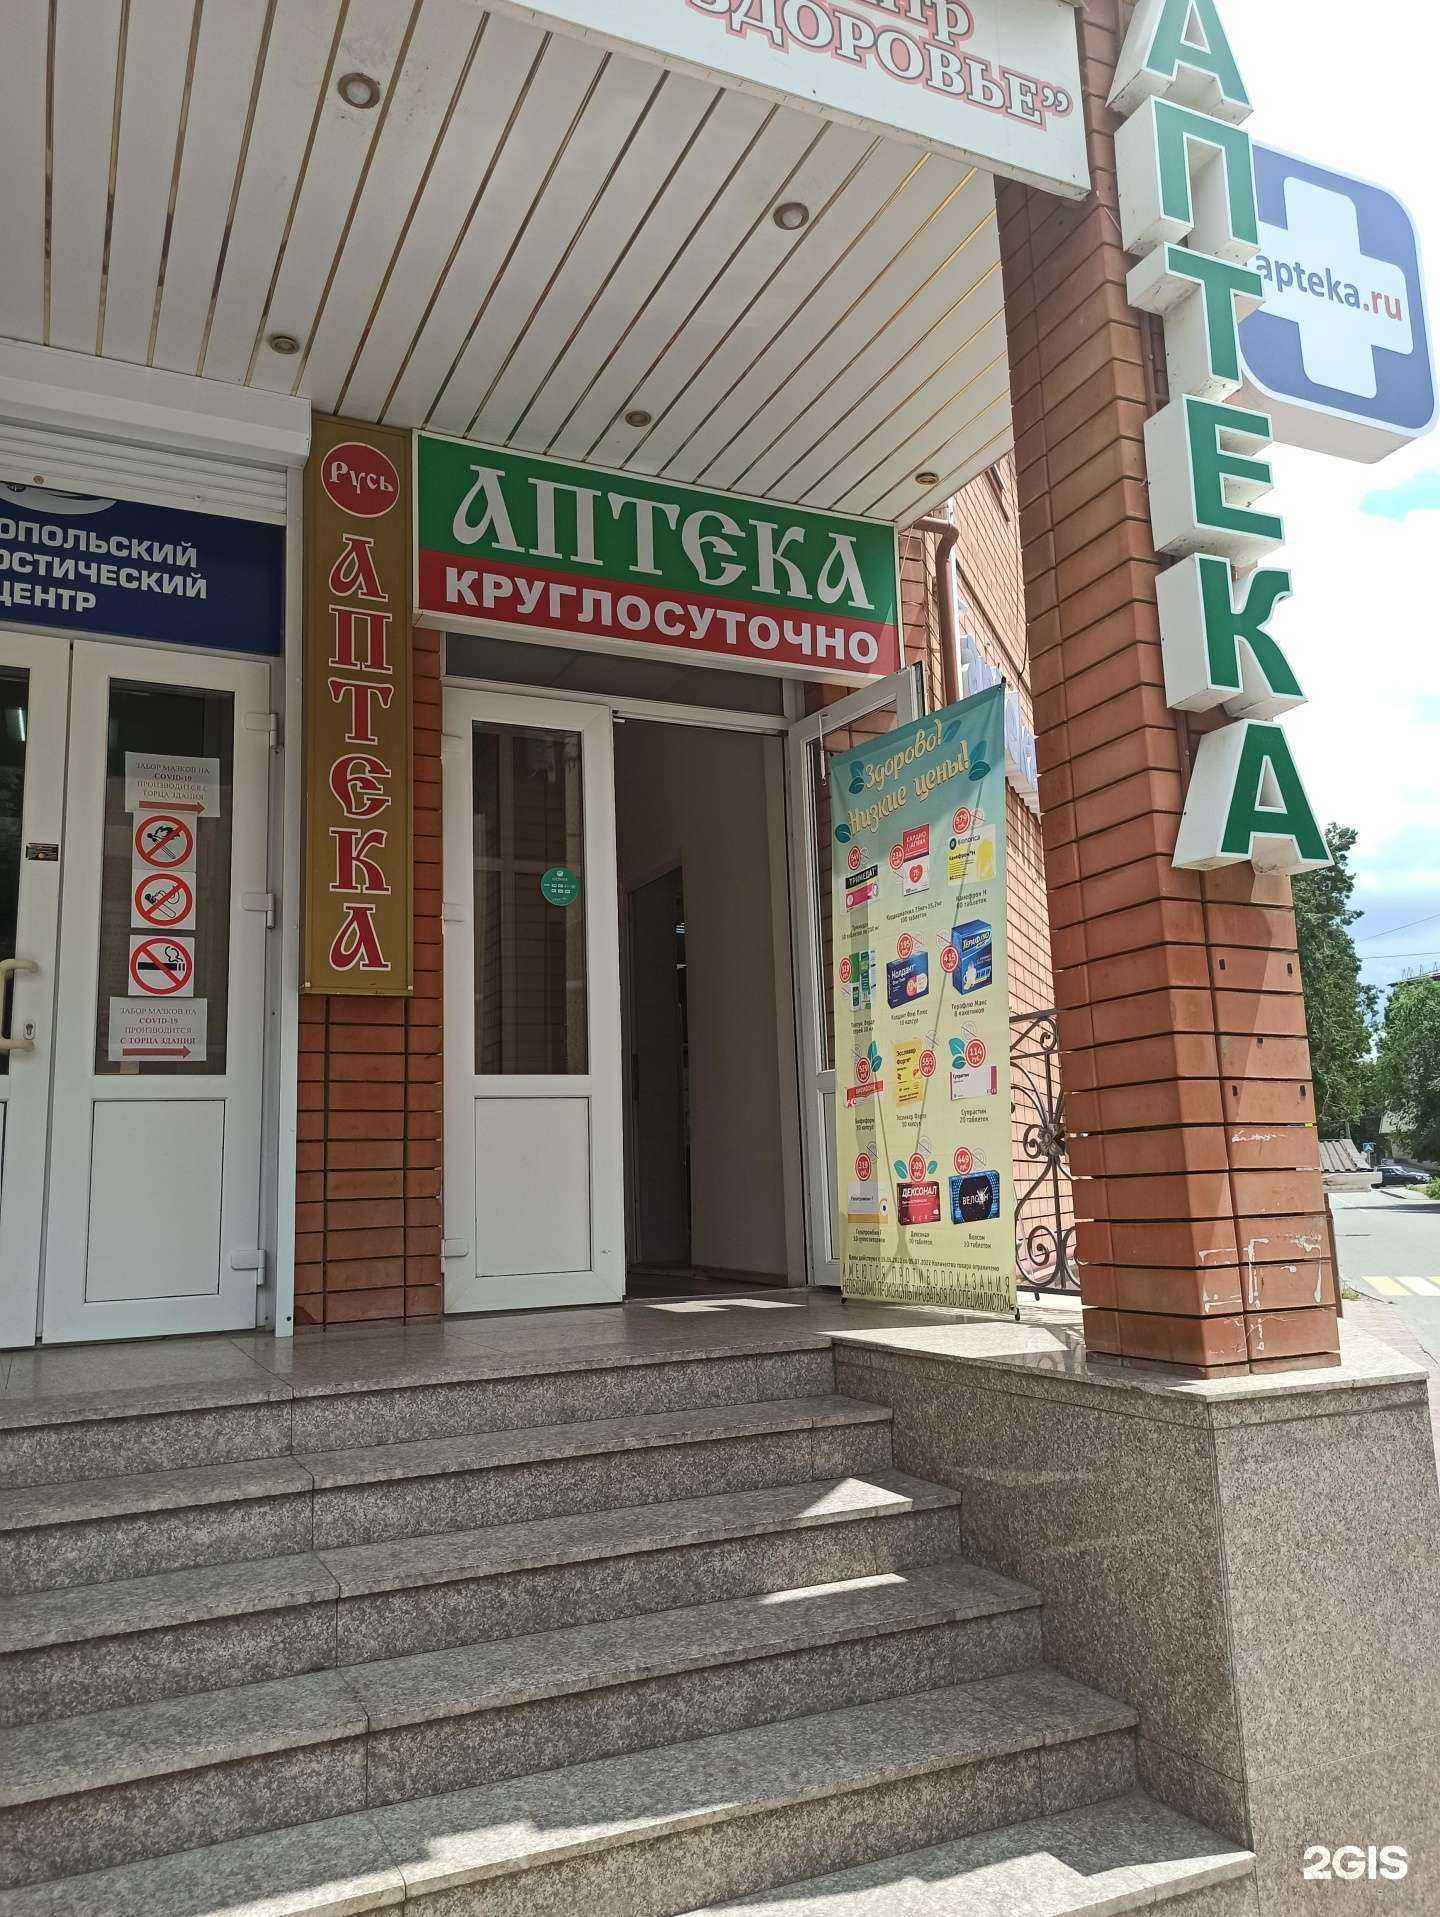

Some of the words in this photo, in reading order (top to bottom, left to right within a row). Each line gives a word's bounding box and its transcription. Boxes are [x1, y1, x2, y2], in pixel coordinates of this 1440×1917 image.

[1255, 254, 1402, 321] apteka.ru
[329, 461, 394, 494] Русь
[1141, 0, 1334, 866] АПТЕКА
[452, 464, 875, 611] АПТЕКА
[445, 565, 879, 664] КРУГЛОСУТОЧНО
[328, 533, 394, 972] АПТЕКА
[849, 785, 907, 836] Низкие
[913, 740, 970, 803] цены!
[864, 719, 943, 793] Здорово!
